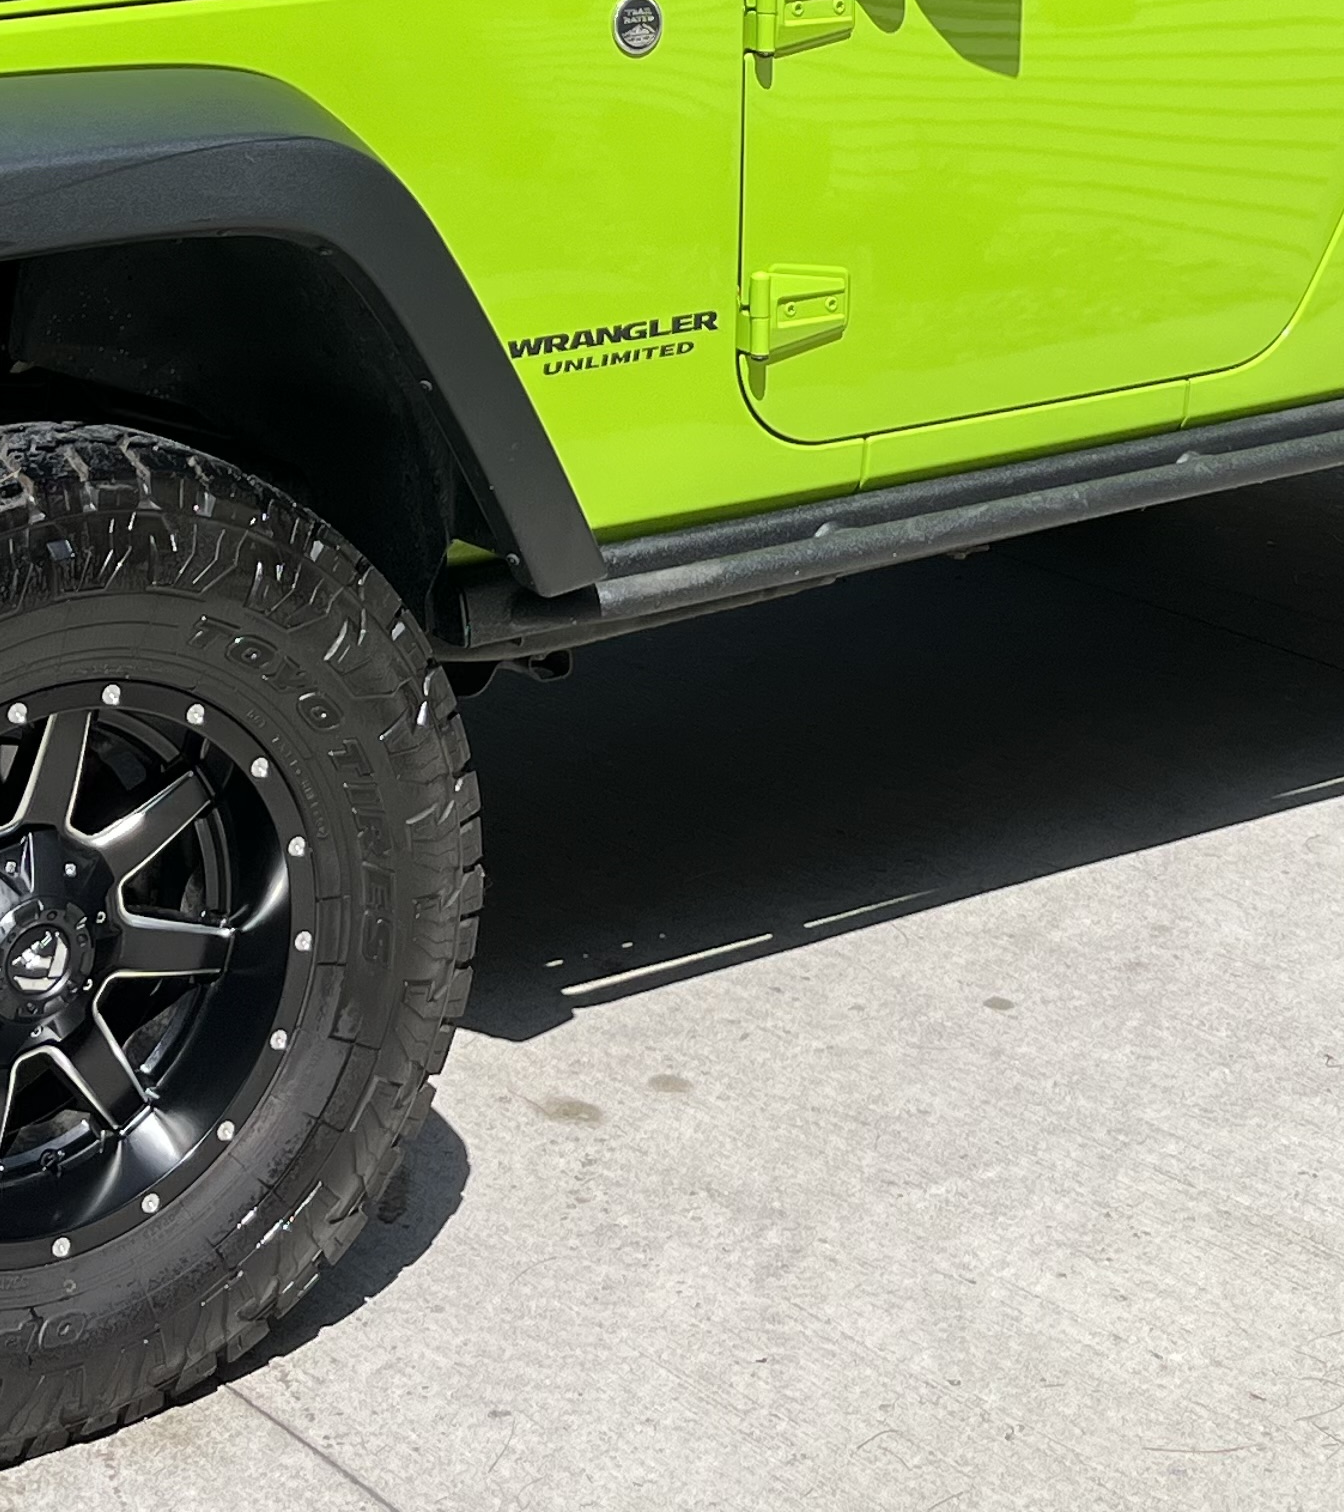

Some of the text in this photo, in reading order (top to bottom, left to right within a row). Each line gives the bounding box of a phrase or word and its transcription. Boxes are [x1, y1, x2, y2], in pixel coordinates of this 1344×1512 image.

[507, 311, 718, 359] WRANGLER
[543, 341, 695, 376] UNLIMITED
[185, 615, 344, 732] TOYO
[327, 737, 397, 970] TIRES
